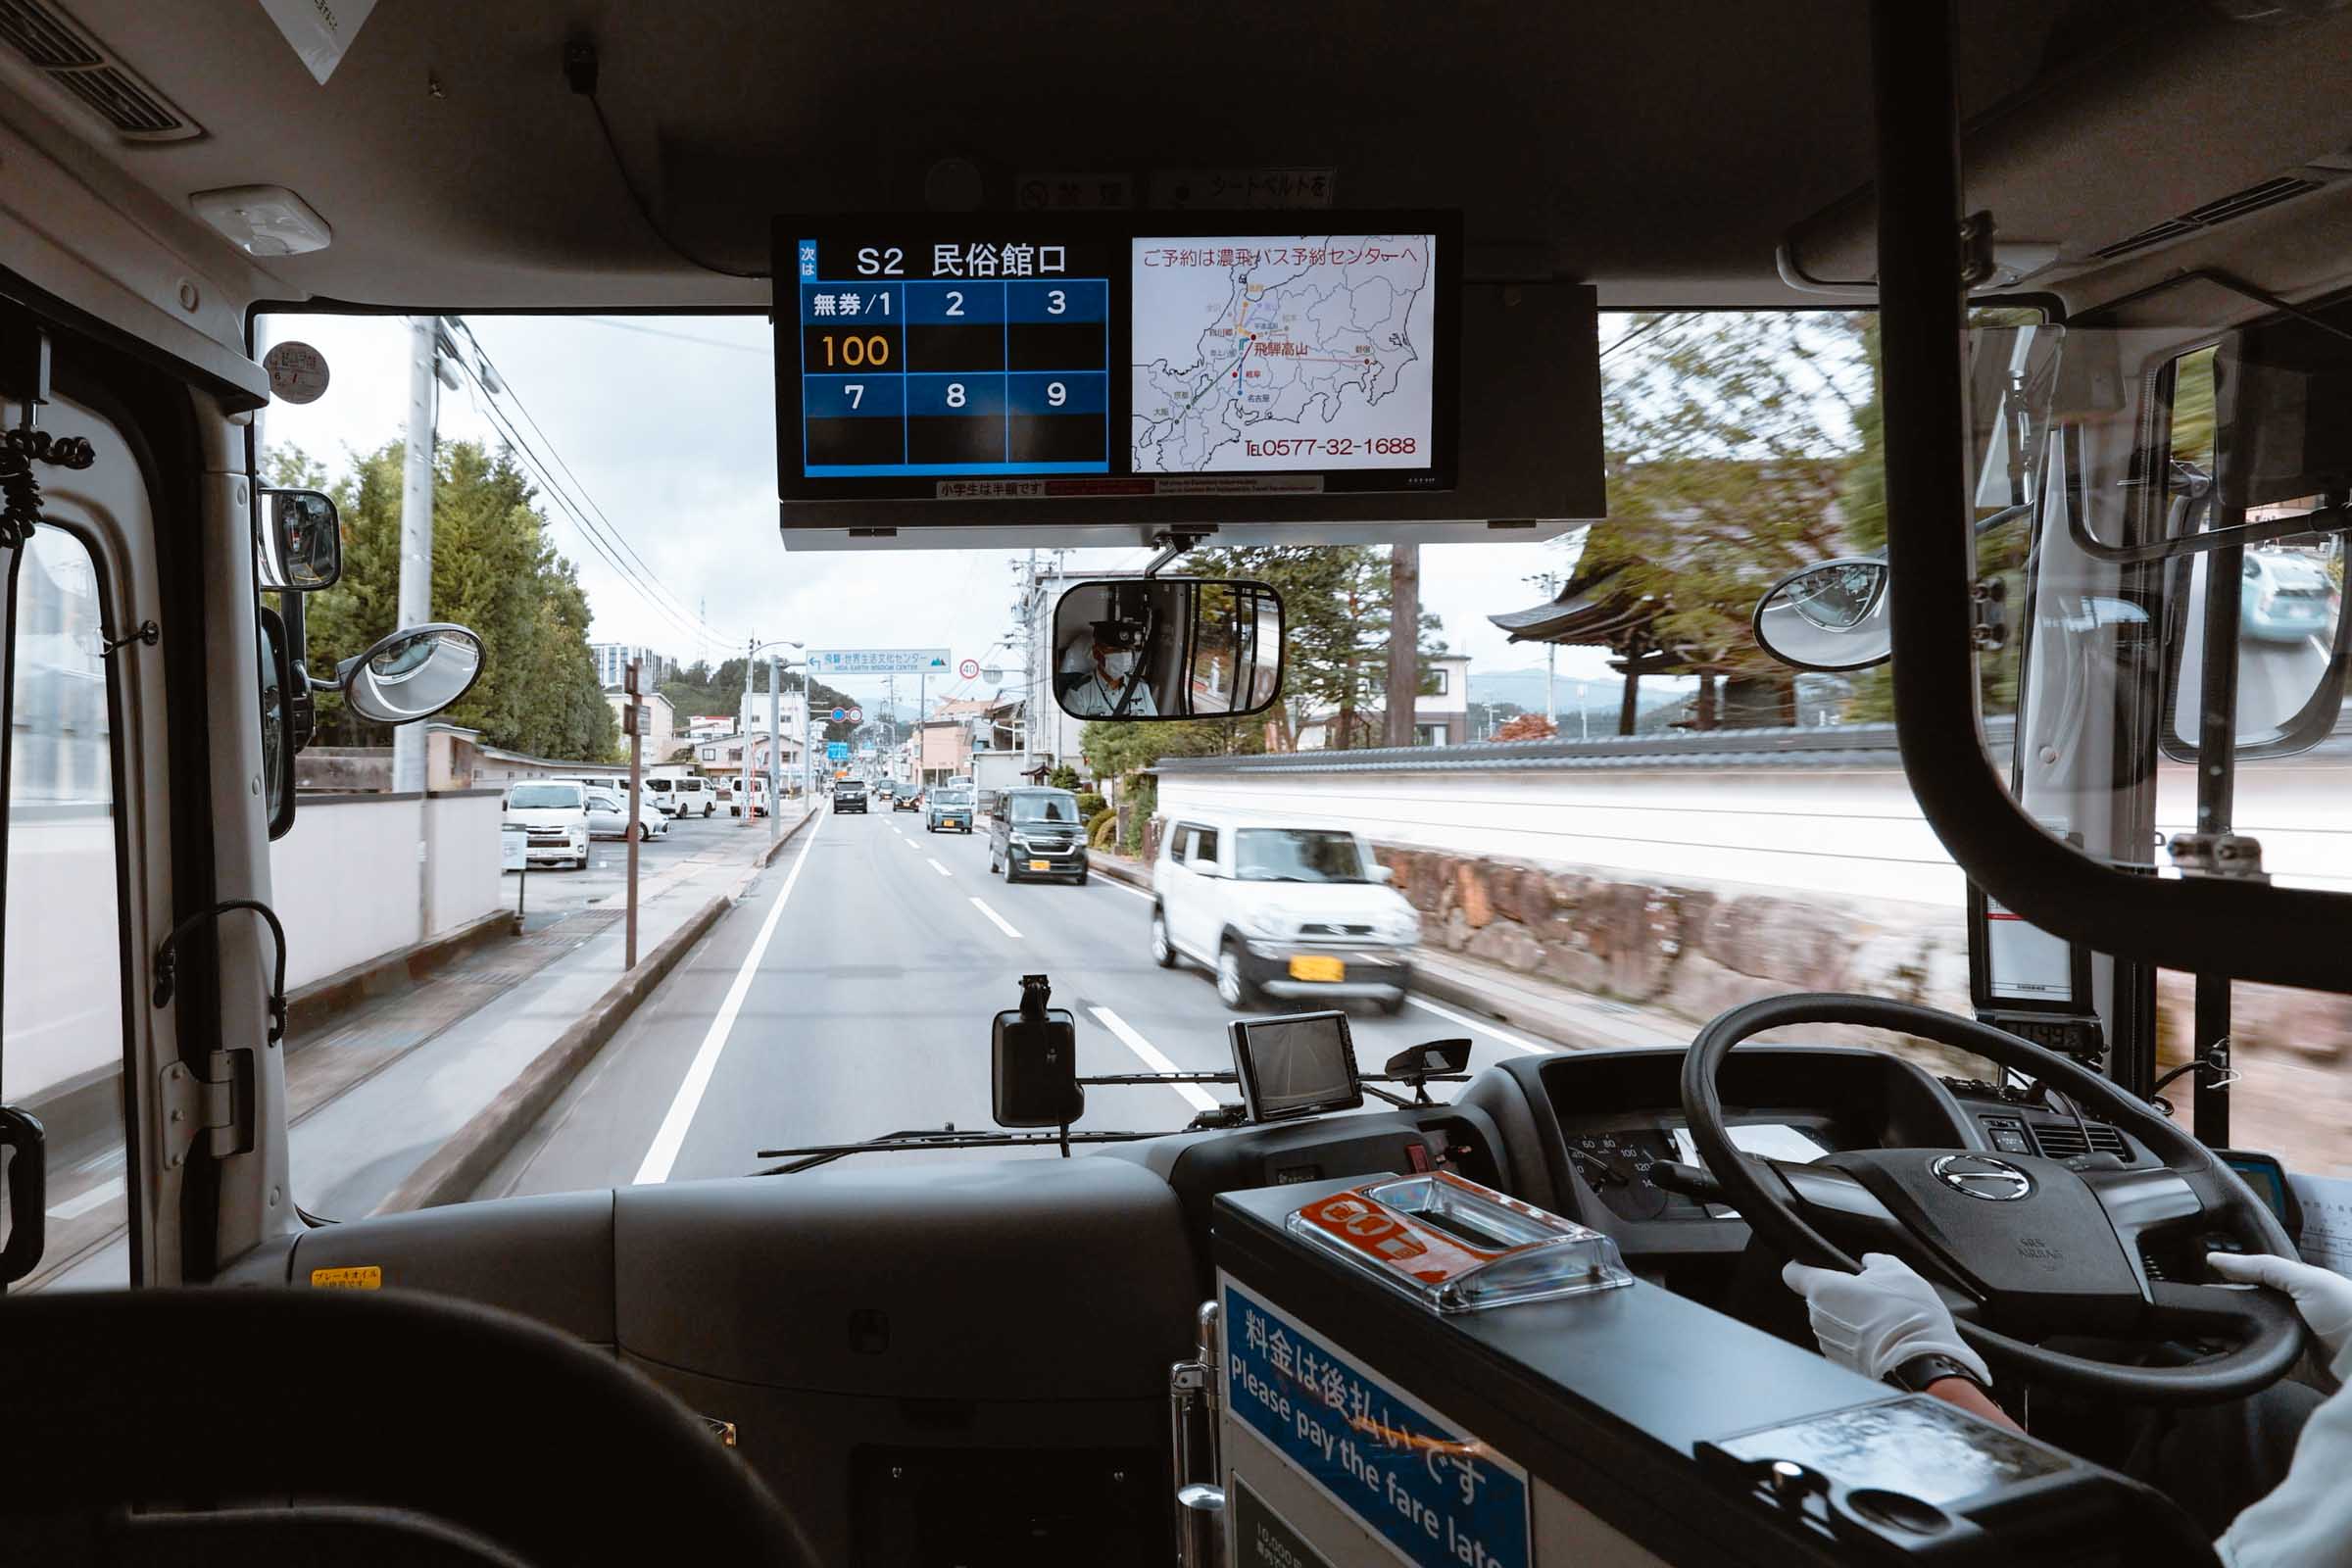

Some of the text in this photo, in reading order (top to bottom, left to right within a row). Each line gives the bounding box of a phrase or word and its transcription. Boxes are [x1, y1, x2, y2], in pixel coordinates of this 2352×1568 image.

[801, 245, 816, 276] 次は
[858, 244, 1066, 277] S2 民俗館口
[1144, 246, 1418, 268] ご予約は濃飛バス予約センターへ
[946, 291, 964, 316] 2
[1048, 291, 1066, 315] 3
[822, 335, 889, 367] 100
[844, 385, 864, 410] 7
[947, 384, 966, 408] 8
[1047, 383, 1066, 407] 9
[963, 664, 975, 675] 40
[1621, 1149, 1638, 1158] 100
[1636, 1162, 1650, 1173] 120
[1246, 1309, 1486, 1505] 料金は後払いです
[1231, 1353, 1291, 1422] Please
[1297, 1409, 1334, 1464] pay
[1341, 1437, 1380, 1492] the
[1386, 1471, 1440, 1540] fare
